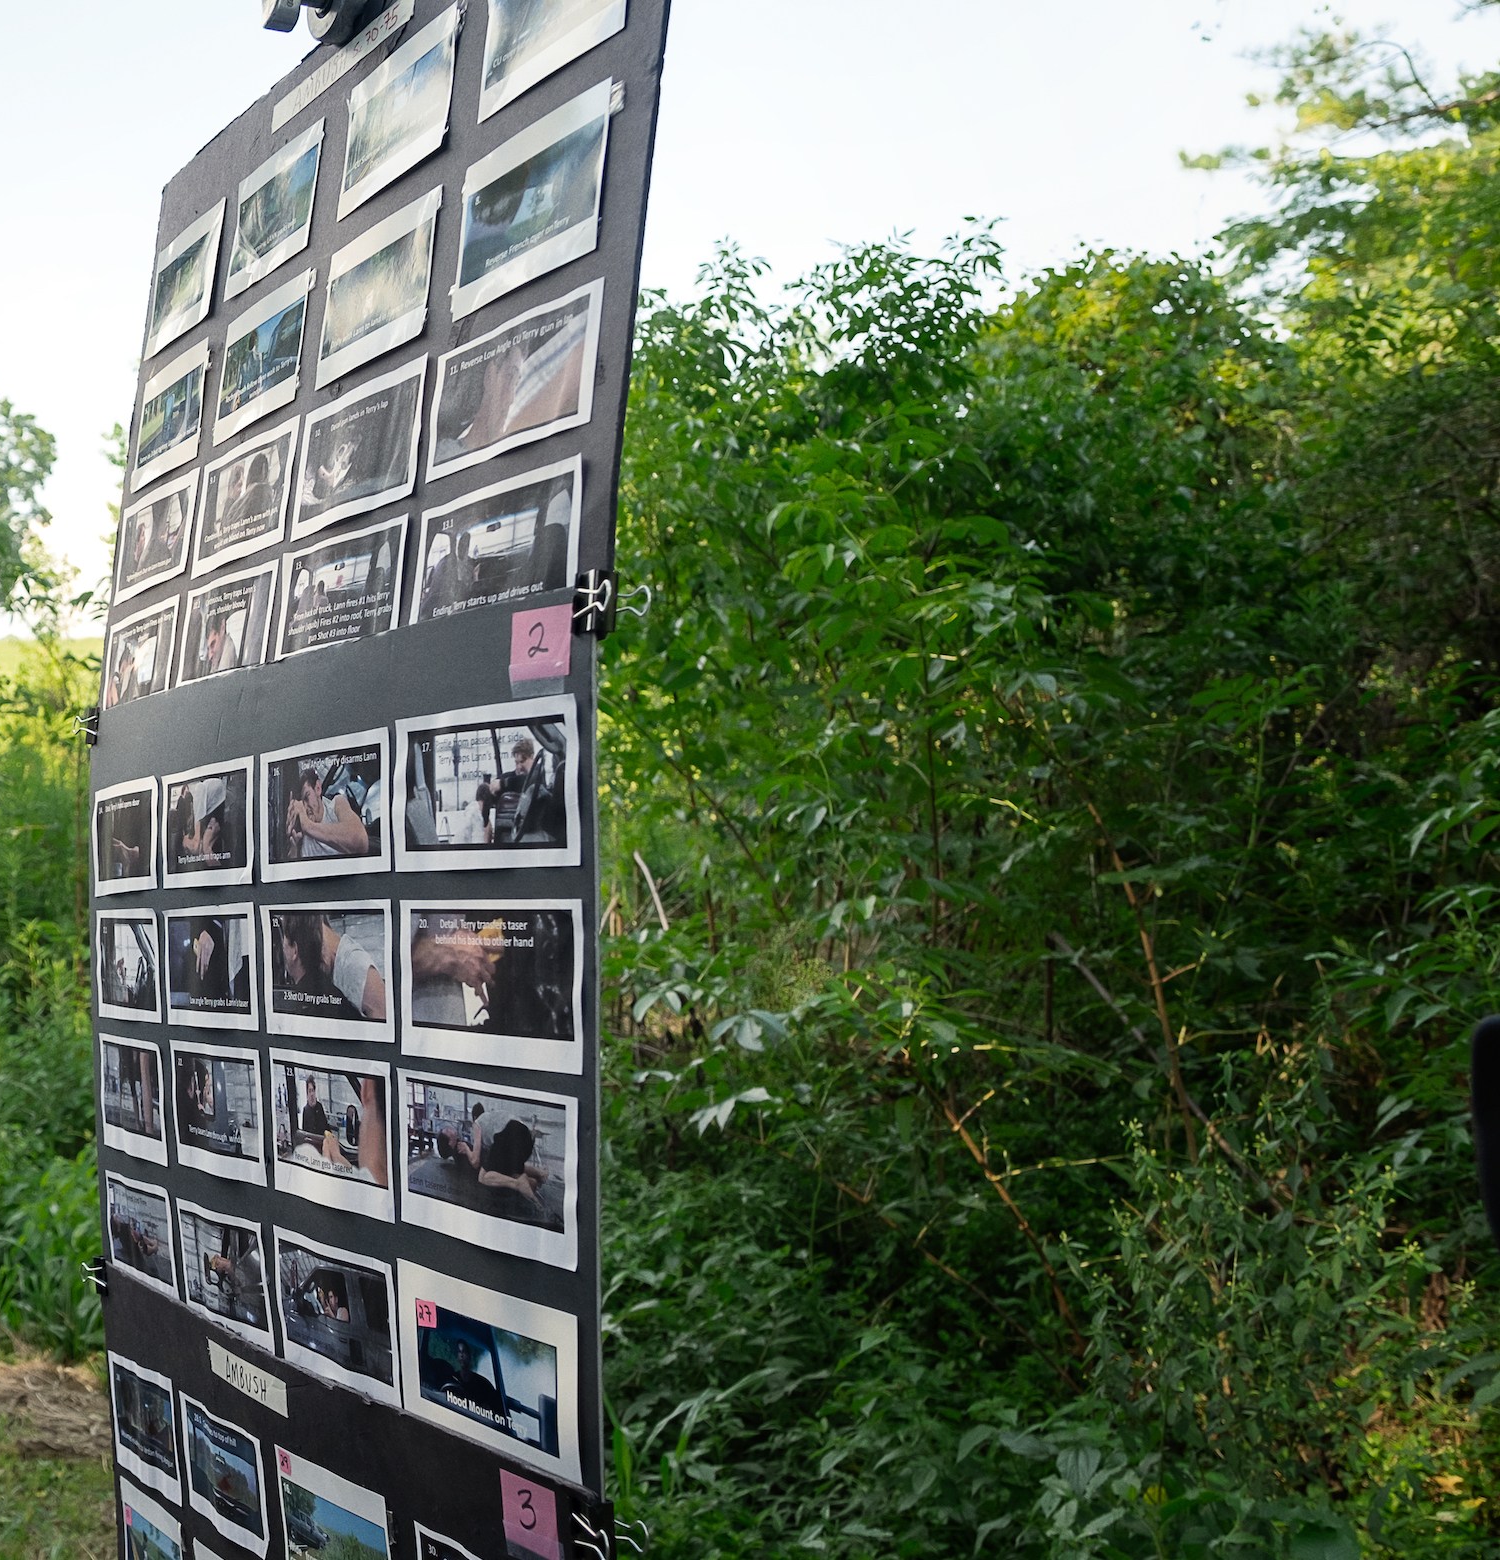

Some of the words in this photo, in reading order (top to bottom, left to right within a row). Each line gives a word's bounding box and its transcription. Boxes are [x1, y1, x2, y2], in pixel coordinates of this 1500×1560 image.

[485, 250, 508, 268] Reverse
[554, 216, 570, 230] Terry
[450, 364, 458, 376] 11.
[460, 356, 482, 371] Reverse
[484, 349, 496, 361] Low
[496, 341, 512, 357] Angle
[512, 336, 521, 346] CU
[522, 328, 538, 341] Terry
[540, 323, 554, 336] gun
[556, 318, 562, 328] in
[442, 518, 454, 530] 13.1
[452, 600, 466, 612] Terry
[466, 594, 486, 608] starts
[487, 594, 497, 604] up
[498, 589, 510, 601] and
[510, 585, 530, 598] drives
[530, 581, 544, 593] out
[334, 602, 346, 610] Lann
[346, 598, 358, 608] fires
[320, 616, 332, 627] Fires
[340, 612, 350, 622] into
[364, 608, 376, 619] Terry
[308, 634, 316, 644] gun
[317, 630, 329, 640] Shot
[336, 627, 346, 636] into
[347, 624, 361, 634] floor
[527, 622, 549, 658] 2
[422, 742, 432, 753] 17.
[326, 756, 340, 767] Terry
[340, 754, 363, 765] disarms
[364, 752, 376, 762] Lann
[472, 750, 492, 762] Lann's
[419, 919, 429, 929] 20.
[440, 919, 458, 930] Detail,
[460, 920, 476, 931] Terry
[508, 920, 528, 931] taser
[435, 934, 456, 944] behind
[458, 934, 468, 944] his
[468, 935, 483, 946] back
[484, 936, 490, 946] to
[492, 936, 512, 948] other
[514, 936, 534, 948] hand
[284, 992, 298, 1001] 2-Shot
[298, 994, 304, 1002] CU
[304, 993, 316, 1004] Terry
[316, 994, 329, 1006] grabs
[330, 996, 342, 1005] Taser
[286, 1068, 294, 1076] 23.
[428, 1090, 436, 1100] 24
[322, 1160, 331, 1170] gets
[332, 1162, 353, 1174] tasered
[418, 1305, 432, 1323] 27
[226, 1355, 267, 1402] AMBUSH
[446, 1390, 468, 1410] Hood
[468, 1401, 494, 1422] Mount
[494, 1413, 506, 1426] on
[506, 1416, 528, 1438] Terry
[518, 1489, 536, 1530] 3
[428, 1544, 438, 1557] 30.
